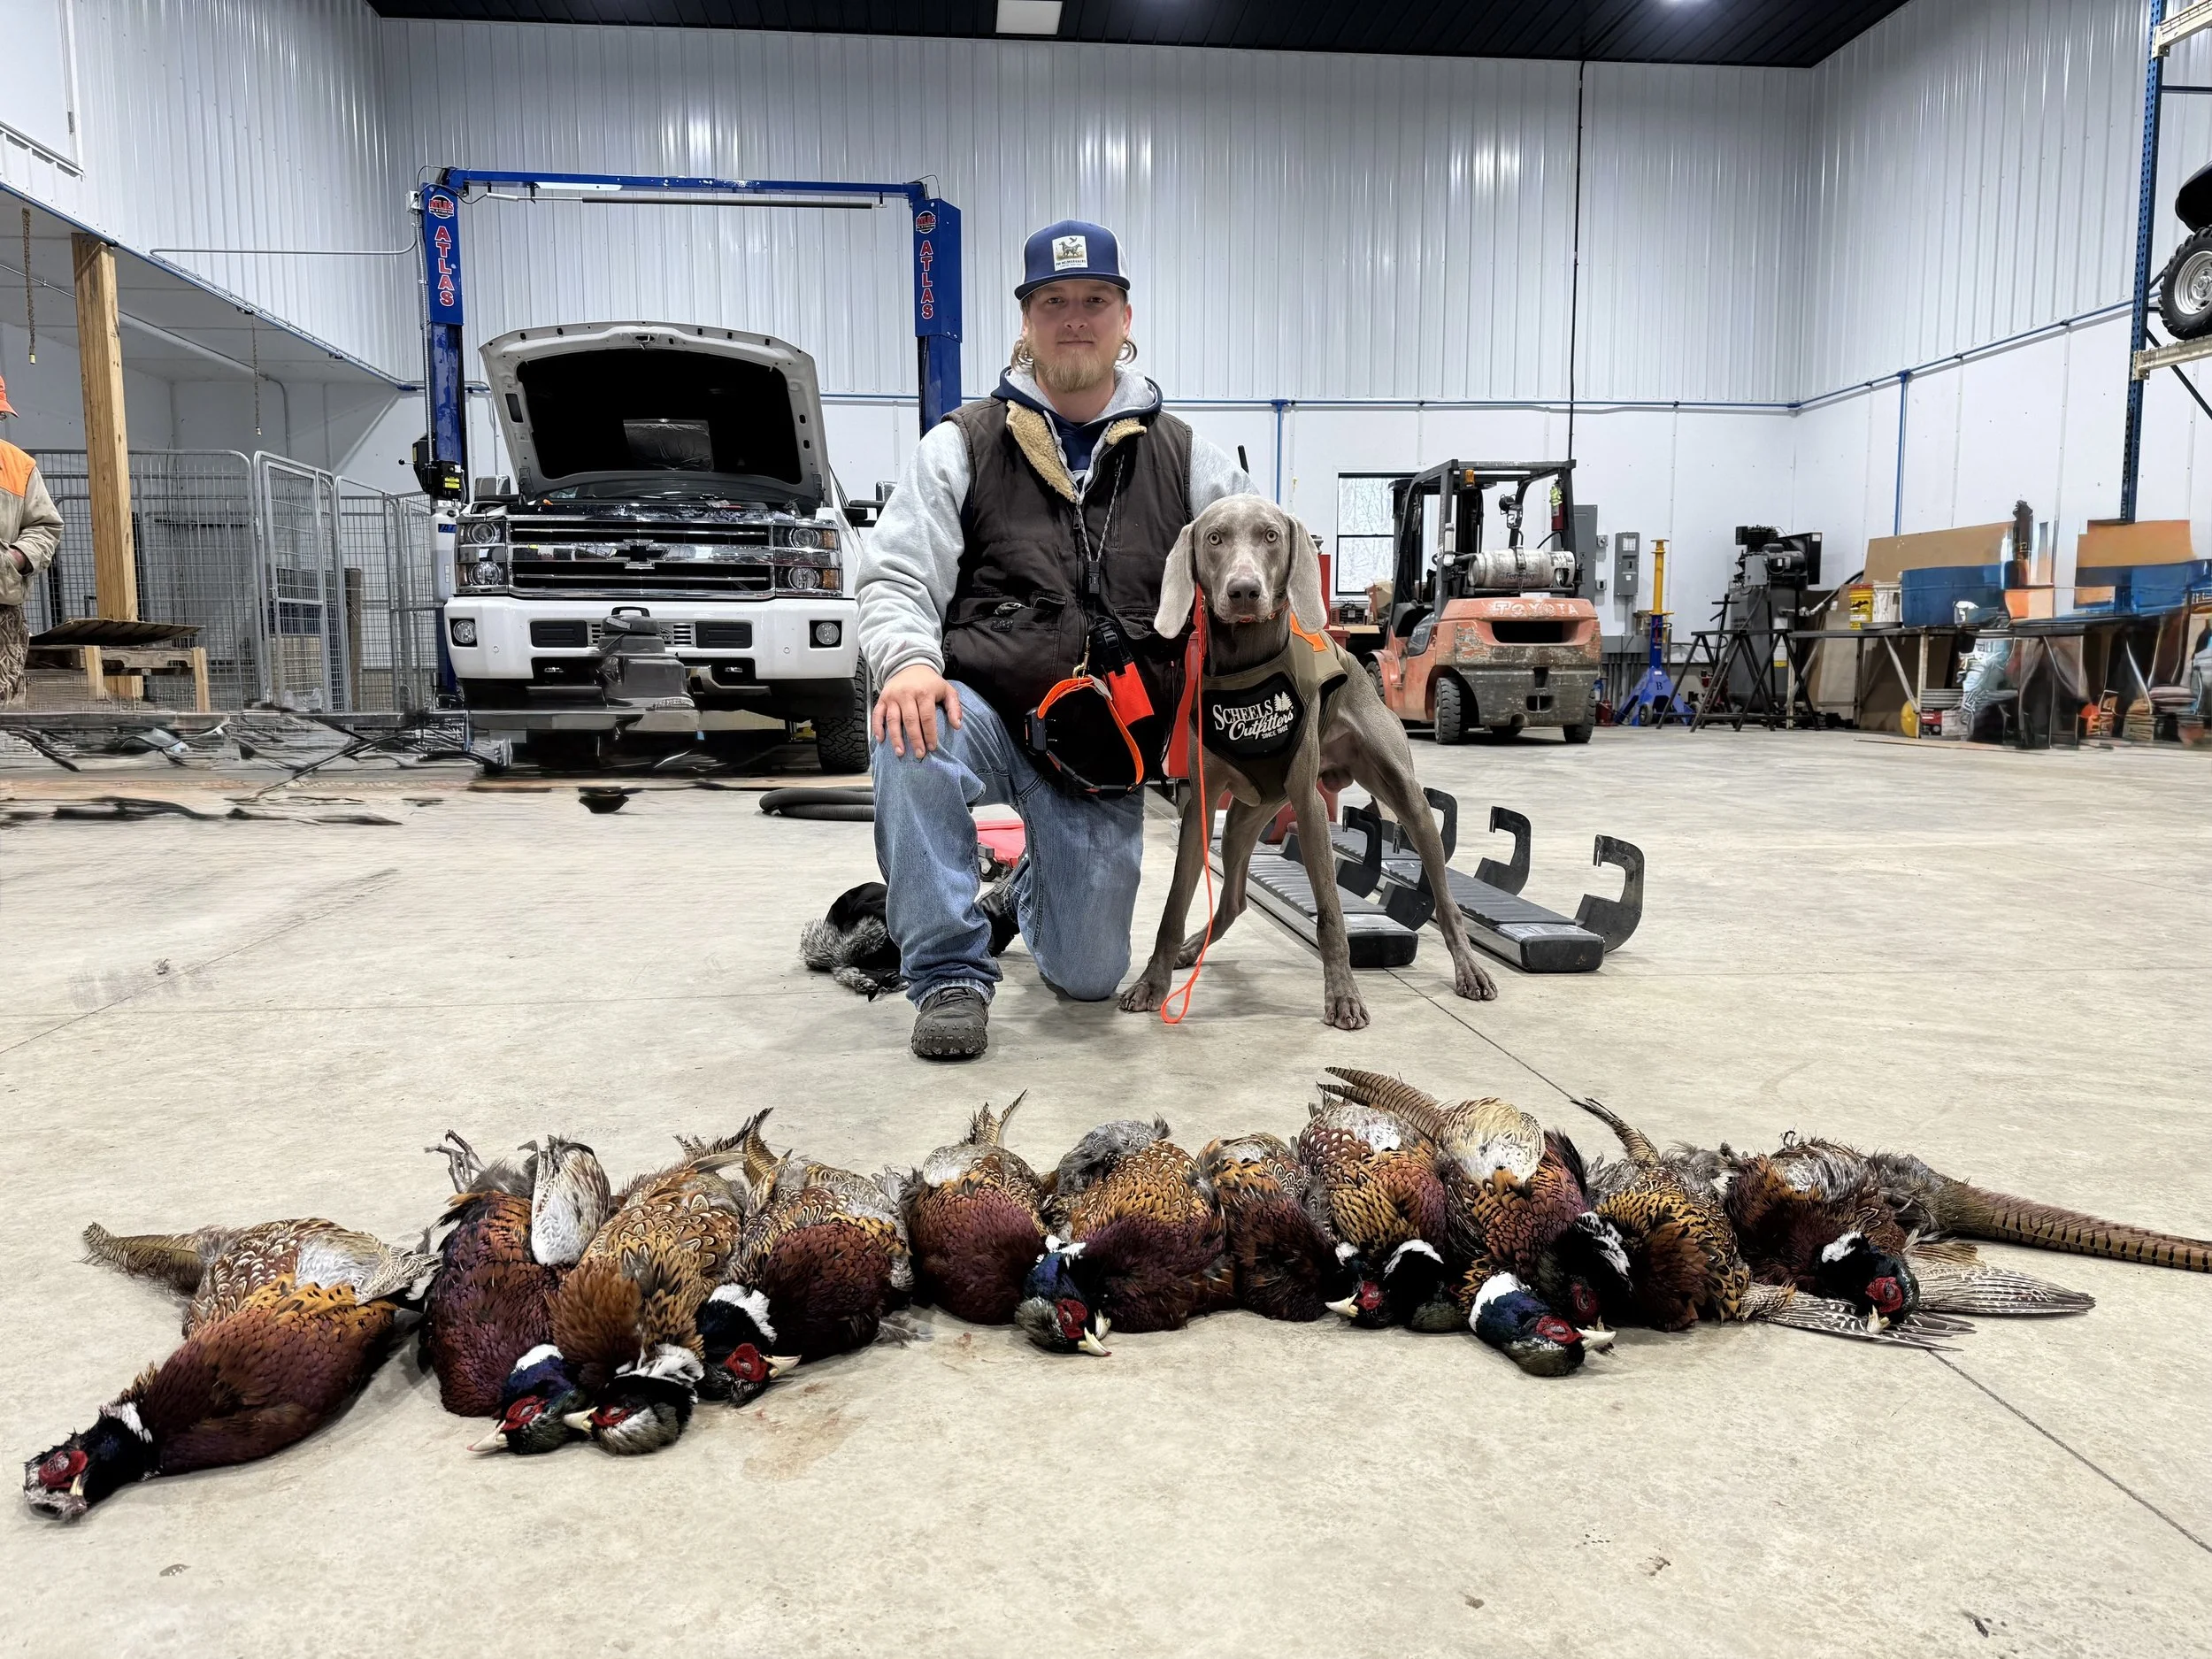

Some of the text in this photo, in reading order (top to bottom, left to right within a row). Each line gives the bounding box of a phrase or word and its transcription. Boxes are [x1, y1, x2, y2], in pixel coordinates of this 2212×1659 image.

[434, 226, 455, 307] ATLAS
[919, 240, 934, 319] ATLAS
[1495, 603, 1578, 617] TOYOTA
[1212, 699, 1274, 731] SCHEELS
[1228, 709, 1294, 741] Outfitters
[1261, 729, 1277, 740] SINCE
